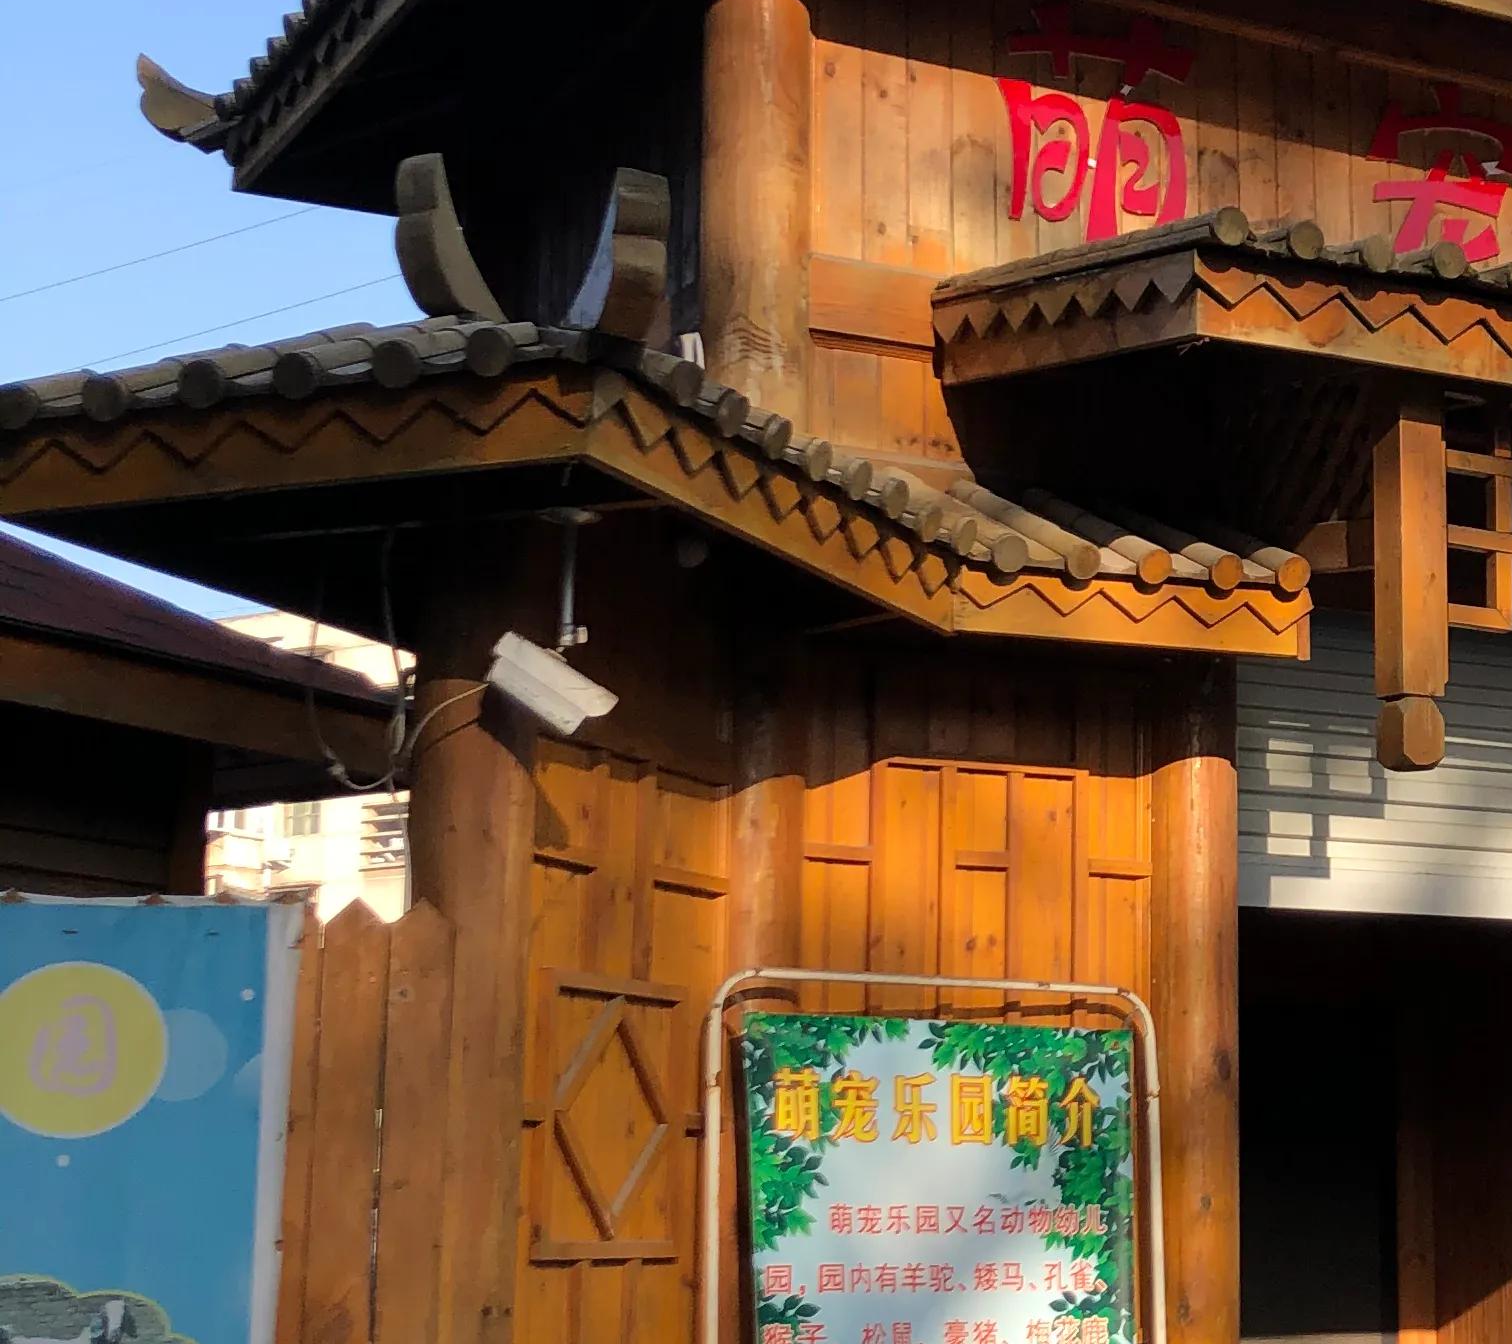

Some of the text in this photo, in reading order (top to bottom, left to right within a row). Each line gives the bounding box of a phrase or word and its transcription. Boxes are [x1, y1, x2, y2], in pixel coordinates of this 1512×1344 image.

[773, 1067, 1102, 1147] 萌宠乐园简介
[830, 1203, 1108, 1235] 萌宠乐园又名动物幼儿
